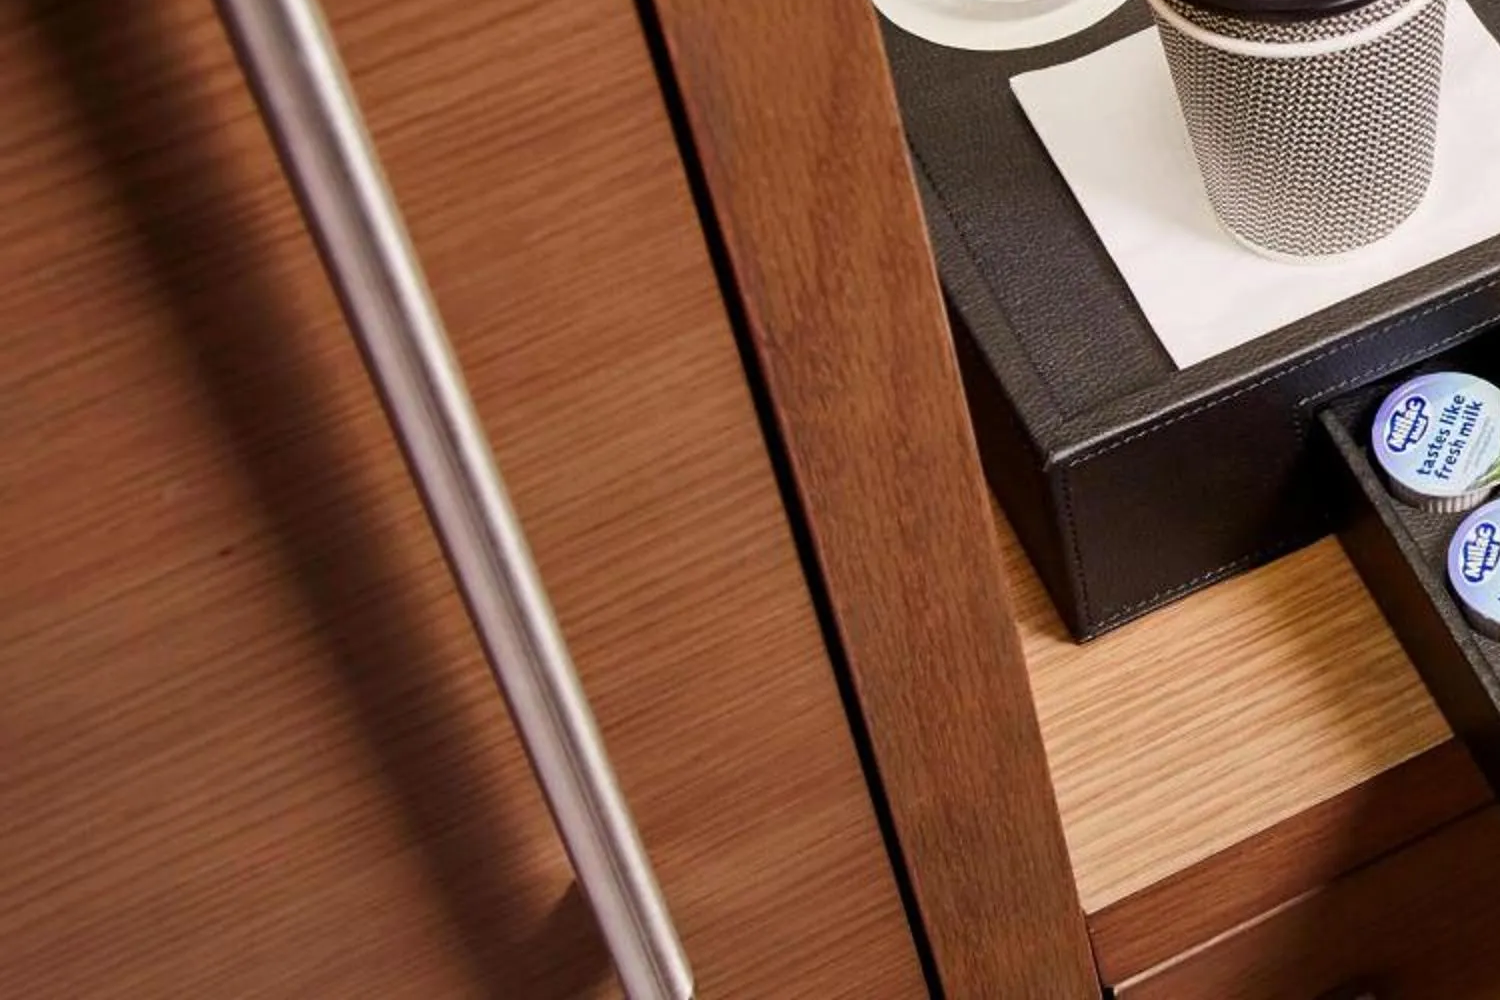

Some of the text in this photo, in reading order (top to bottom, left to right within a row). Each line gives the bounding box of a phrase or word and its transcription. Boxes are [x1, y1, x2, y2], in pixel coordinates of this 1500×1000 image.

[1417, 394, 1465, 476] tastes like
[1434, 439, 1466, 480] fresh
[1459, 400, 1484, 441] milk
